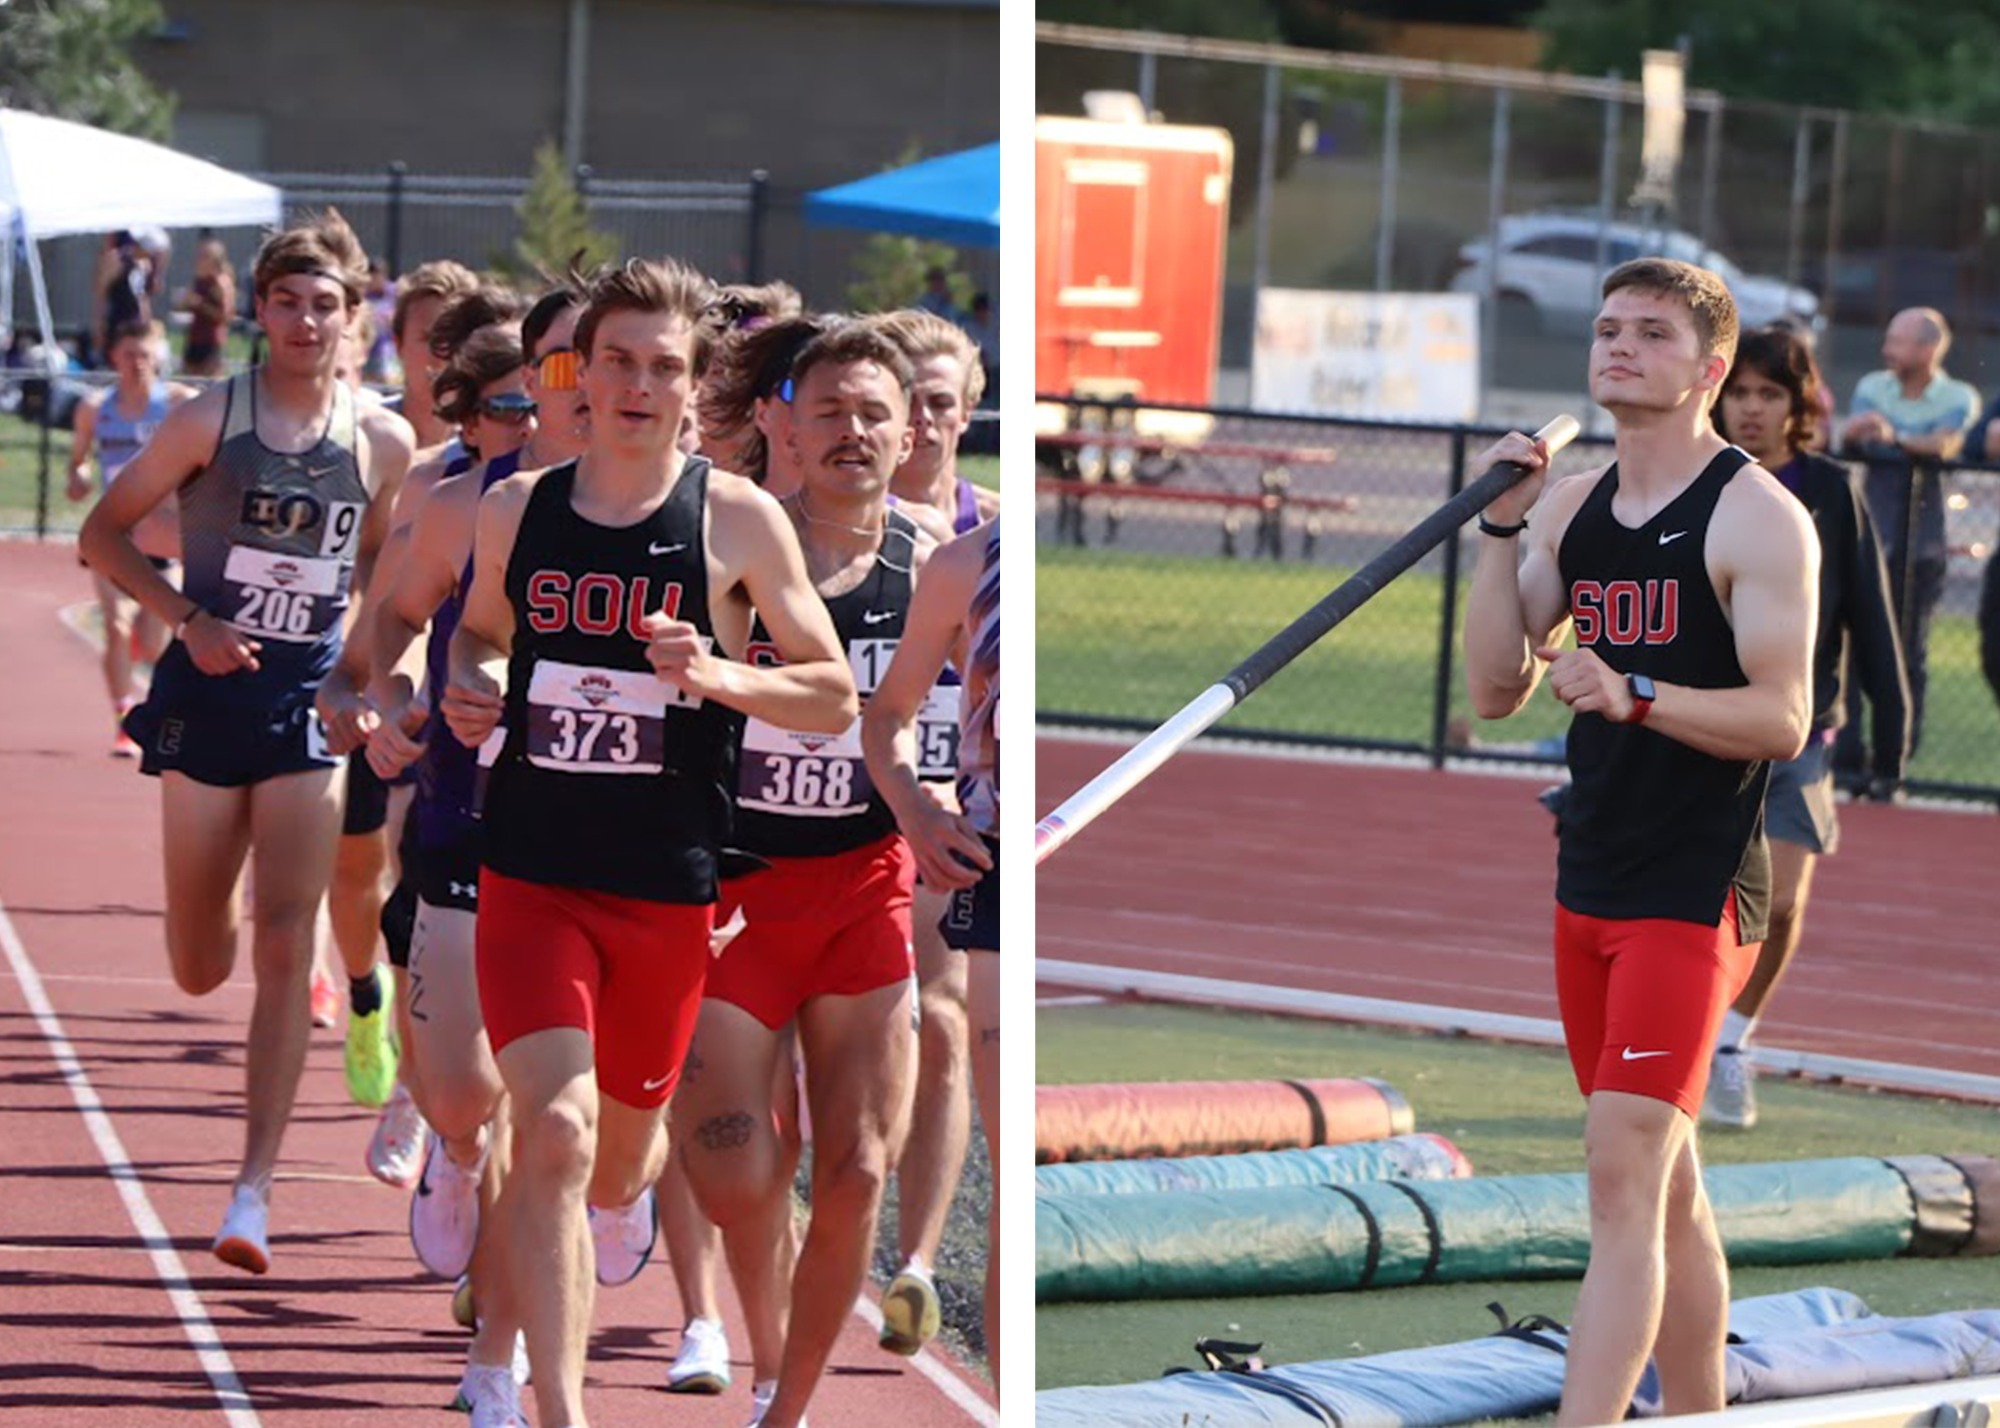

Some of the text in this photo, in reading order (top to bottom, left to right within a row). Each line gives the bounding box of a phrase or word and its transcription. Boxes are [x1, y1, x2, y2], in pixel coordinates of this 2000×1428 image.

[330, 506, 356, 553] 9
[234, 585, 314, 634] 206
[527, 569, 682, 641] SOU
[1571, 578, 1679, 645] SOU
[550, 709, 639, 763] 373
[917, 724, 952, 767] 5
[761, 754, 853, 807] 368
